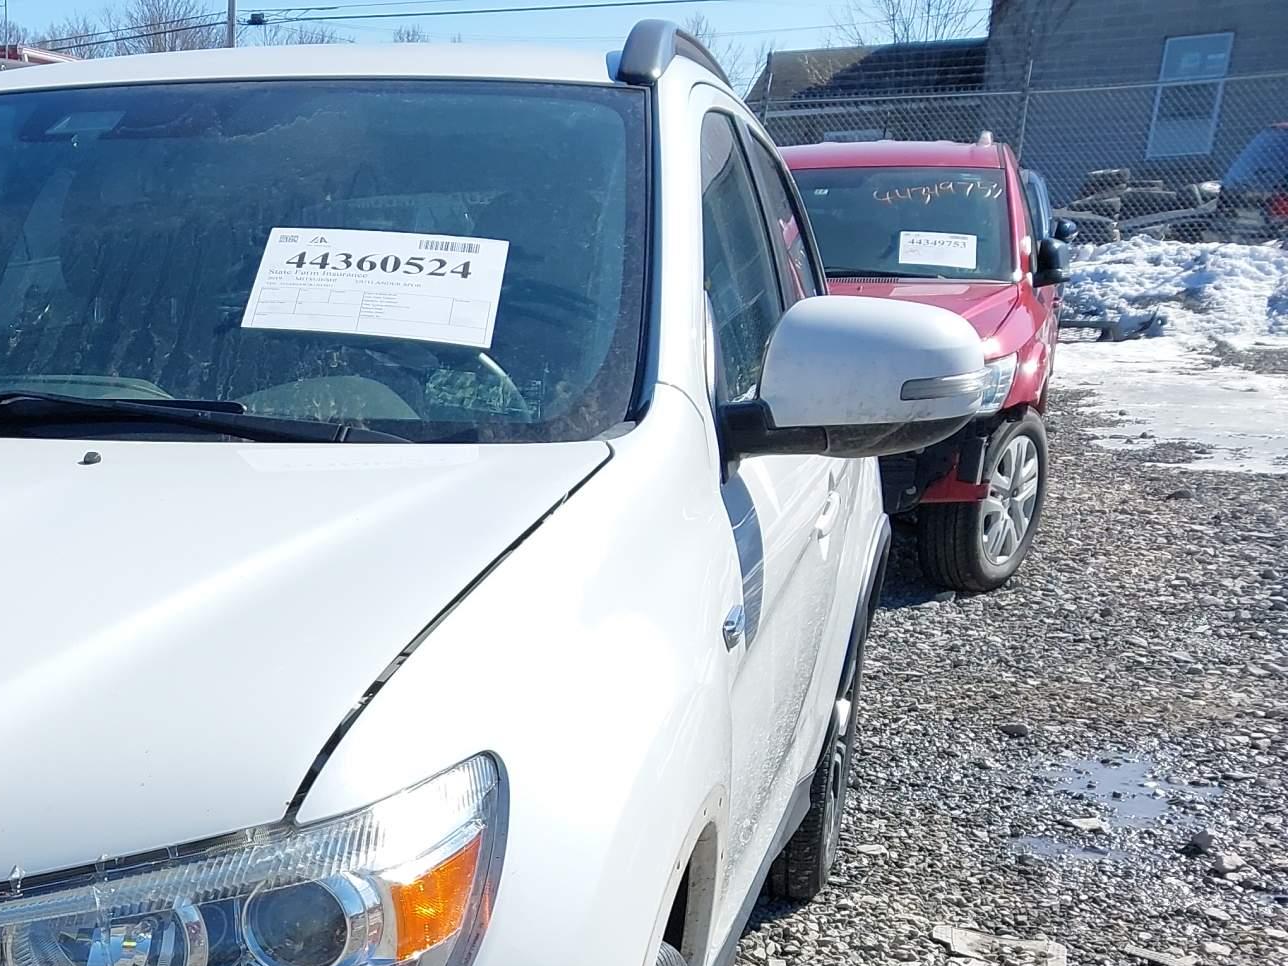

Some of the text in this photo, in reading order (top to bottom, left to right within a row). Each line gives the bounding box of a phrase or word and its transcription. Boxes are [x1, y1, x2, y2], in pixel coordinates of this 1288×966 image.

[907, 238, 968, 249] 44349753
[285, 251, 472, 279] 44360524
[322, 270, 368, 279] Insurance
